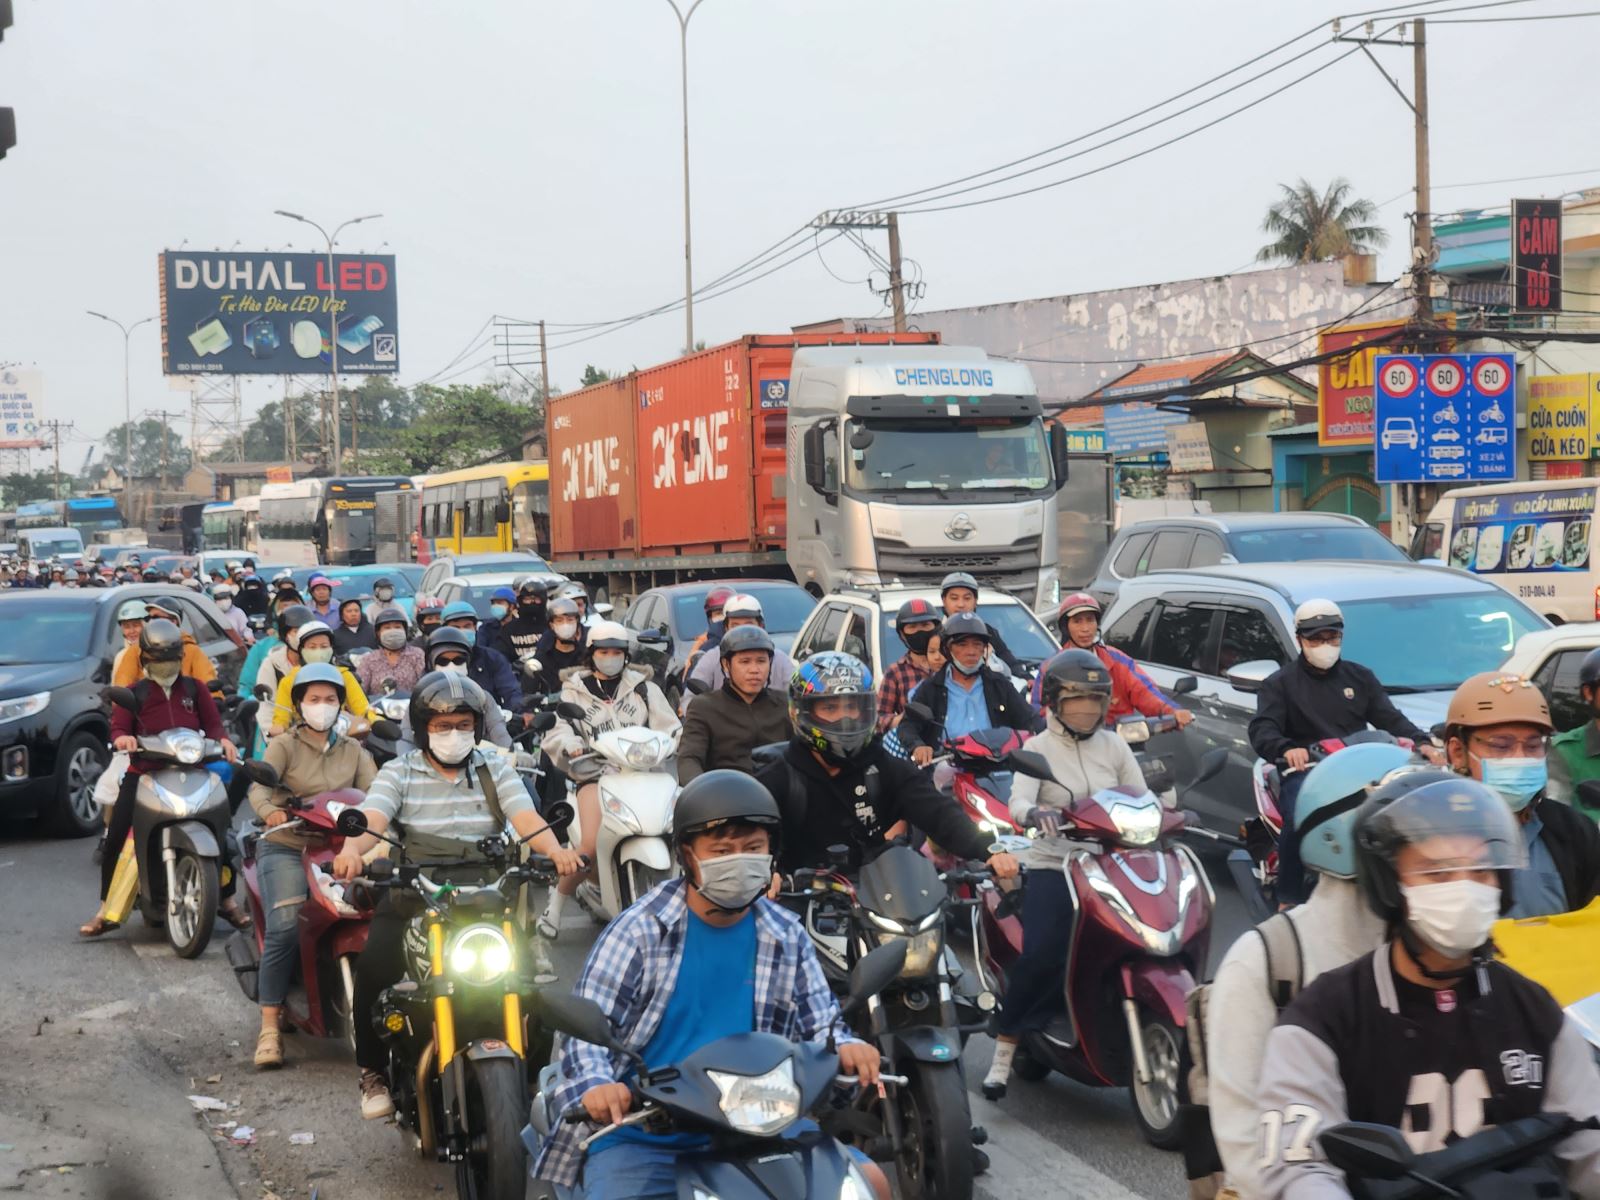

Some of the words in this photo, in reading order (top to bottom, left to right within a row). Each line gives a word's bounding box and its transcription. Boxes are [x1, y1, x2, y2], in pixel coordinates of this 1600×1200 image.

[175, 259, 305, 290] DUHAL
[316, 261, 387, 291] LED
[290, 295, 319, 312] LED
[895, 368, 993, 386] CHENGLONG
[1391, 370, 1406, 386] 60
[1438, 370, 1453, 385] 60
[1484, 369, 1499, 384] 60
[1531, 404, 1552, 428] CỬA
[1556, 403, 1586, 428] CUỐN
[1531, 432, 1555, 456] CỬA
[1560, 433, 1585, 456] KÉO
[1513, 500, 1530, 514] CAO
[1531, 493, 1547, 513] CẤP
[1547, 497, 1569, 512] LINH
